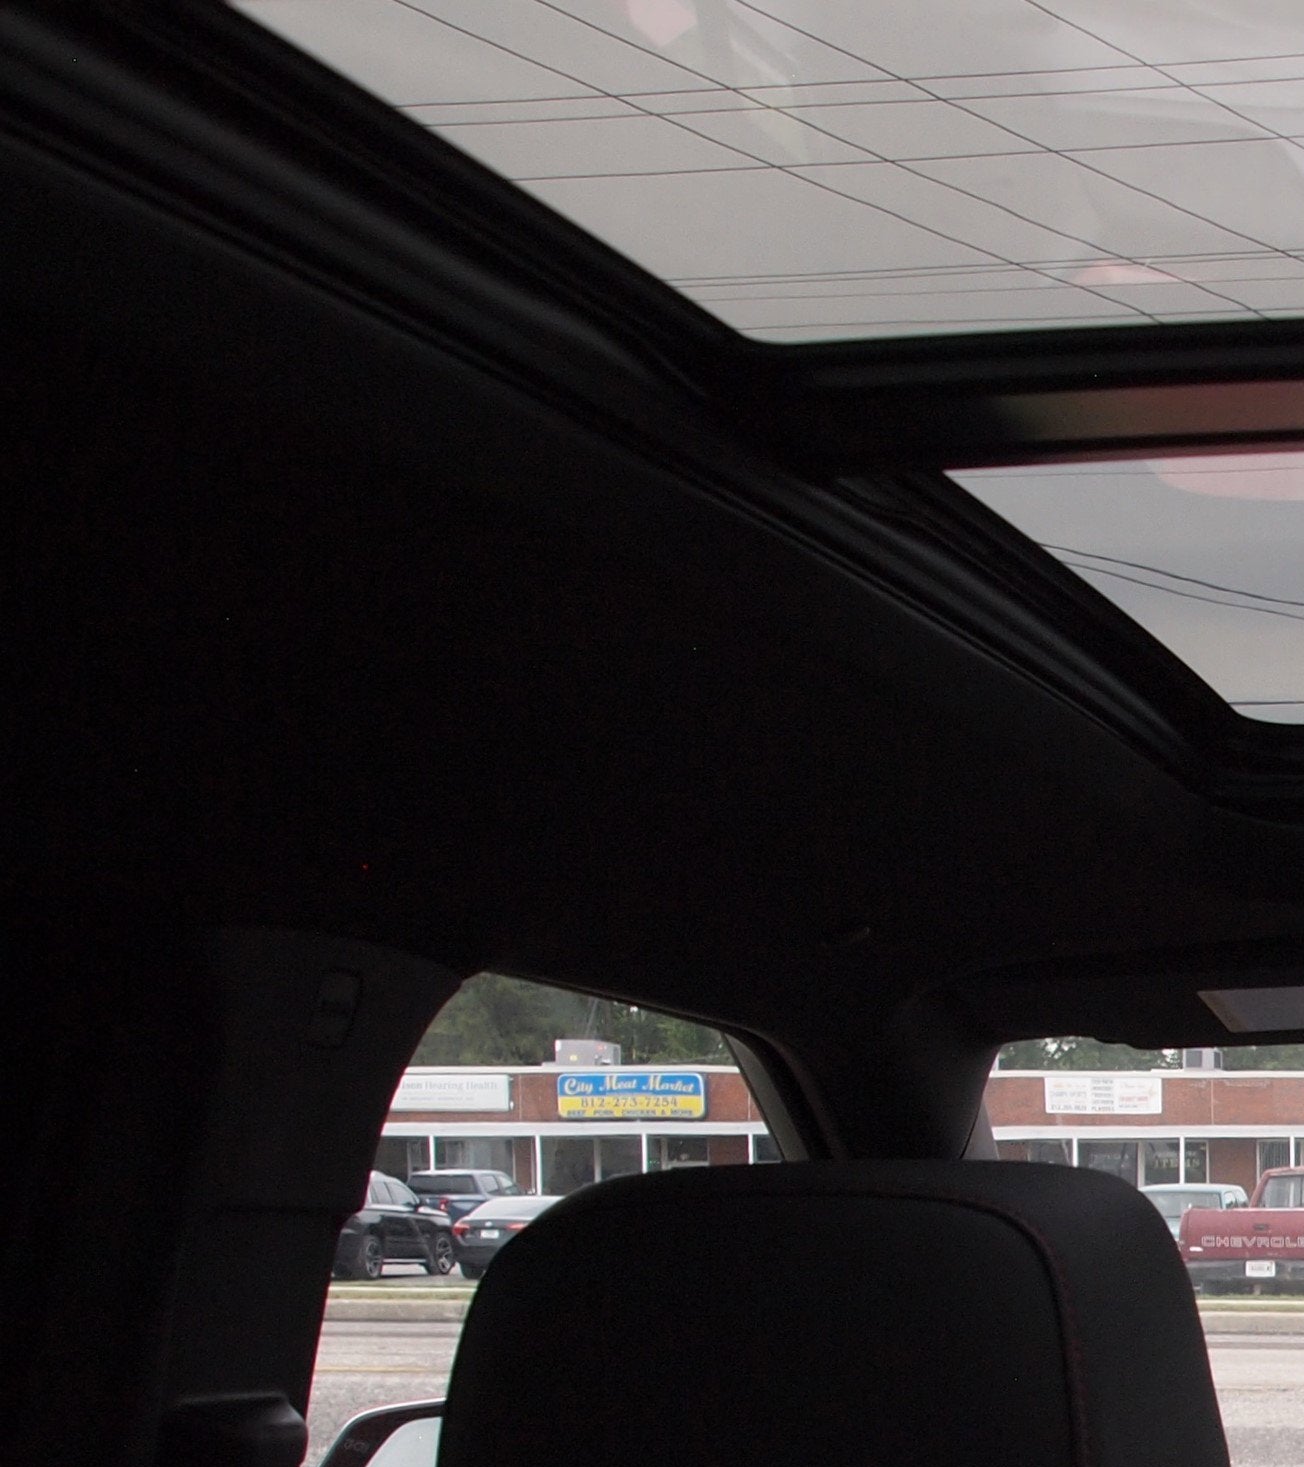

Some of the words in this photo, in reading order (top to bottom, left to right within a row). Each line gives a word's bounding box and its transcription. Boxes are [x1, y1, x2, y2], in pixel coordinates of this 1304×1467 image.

[466, 1080, 497, 1090] Health
[564, 1077, 593, 1095] City
[599, 1075, 637, 1091] Meat
[642, 1075, 694, 1092] Market
